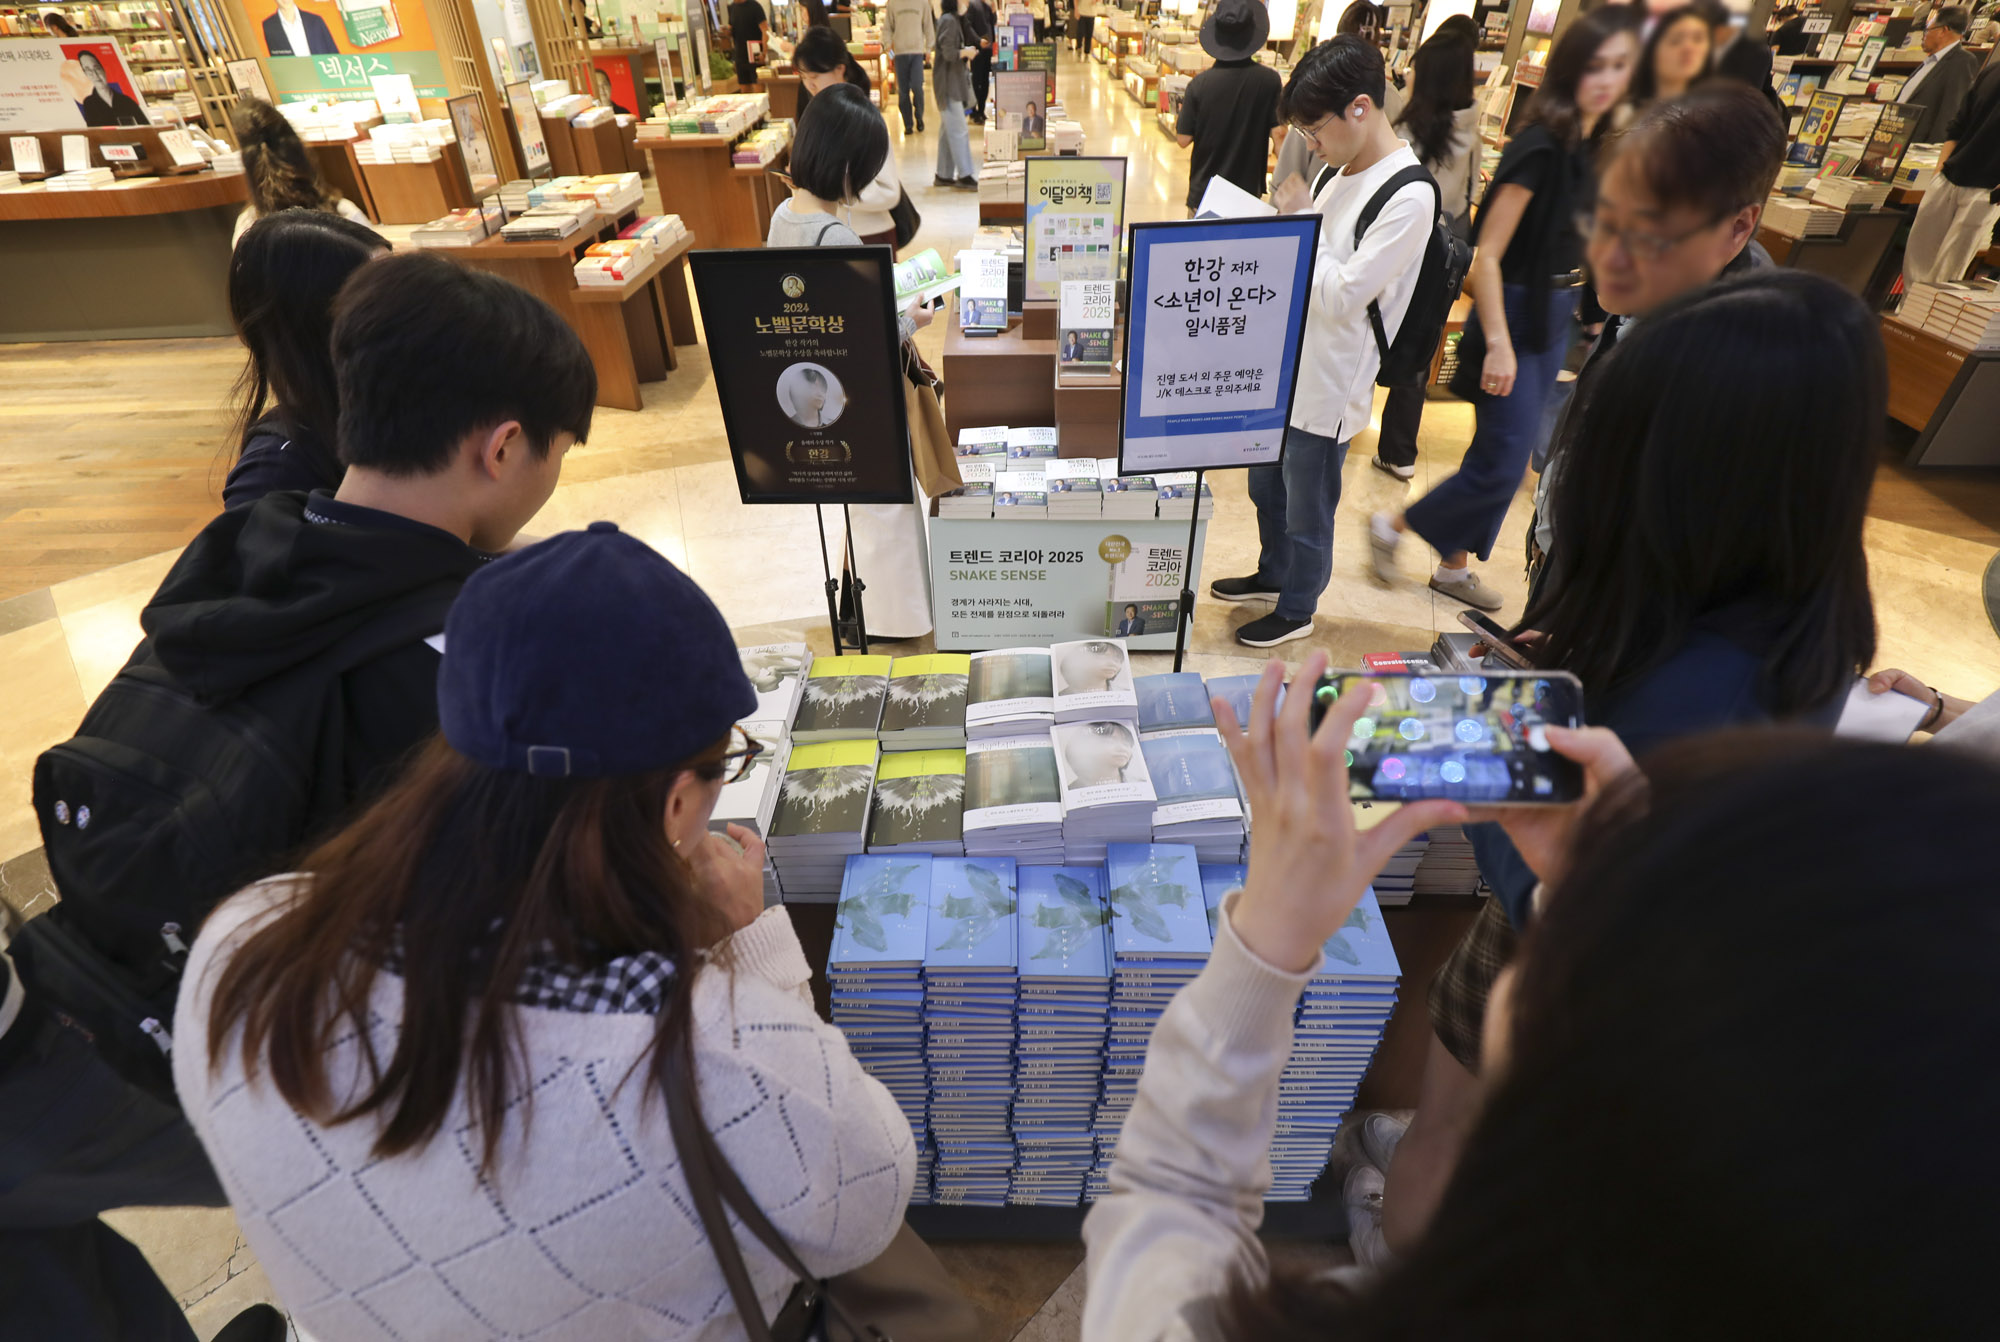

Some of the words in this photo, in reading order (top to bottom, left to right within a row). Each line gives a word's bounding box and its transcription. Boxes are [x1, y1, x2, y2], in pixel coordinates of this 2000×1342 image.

[1185, 256, 1225, 282] 한강
[1231, 260, 1259, 275] 저자
[1083, 284, 1111, 294] 트렌드
[1083, 295, 1111, 305] 코리아
[1154, 287, 1220, 312] <소년이
[1227, 284, 1276, 310] 온다>
[783, 302, 810, 313] 2024
[1082, 307, 1111, 318] 2025
[755, 315, 844, 334] 노벨문학상
[1186, 315, 1247, 337] 일시품절
[1156, 373, 1176, 386] 진열
[1178, 372, 1198, 382] 도서
[1201, 371, 1210, 381] 외
[1213, 369, 1232, 382] 주문
[1235, 368, 1264, 380] 예약은
[1156, 389, 1172, 399] J/K
[1175, 386, 1212, 397] 데스크로
[1215, 382, 1261, 396] 문의주세요
[808, 448, 829, 458] 한강
[949, 550, 994, 564] 트렌드
[998, 550, 1044, 564] 코리아
[1048, 551, 1083, 563] 2025
[1148, 548, 1182, 560] 트렌드
[1146, 561, 1181, 572] 코리아
[950, 570, 997, 580] SNAKE
[1000, 570, 1046, 580] SENSE
[1145, 574, 1180, 586] 2025
[951, 598, 975, 606] 경계가
[978, 598, 1011, 606] 사라지는
[1014, 598, 1033, 607] 시대,
